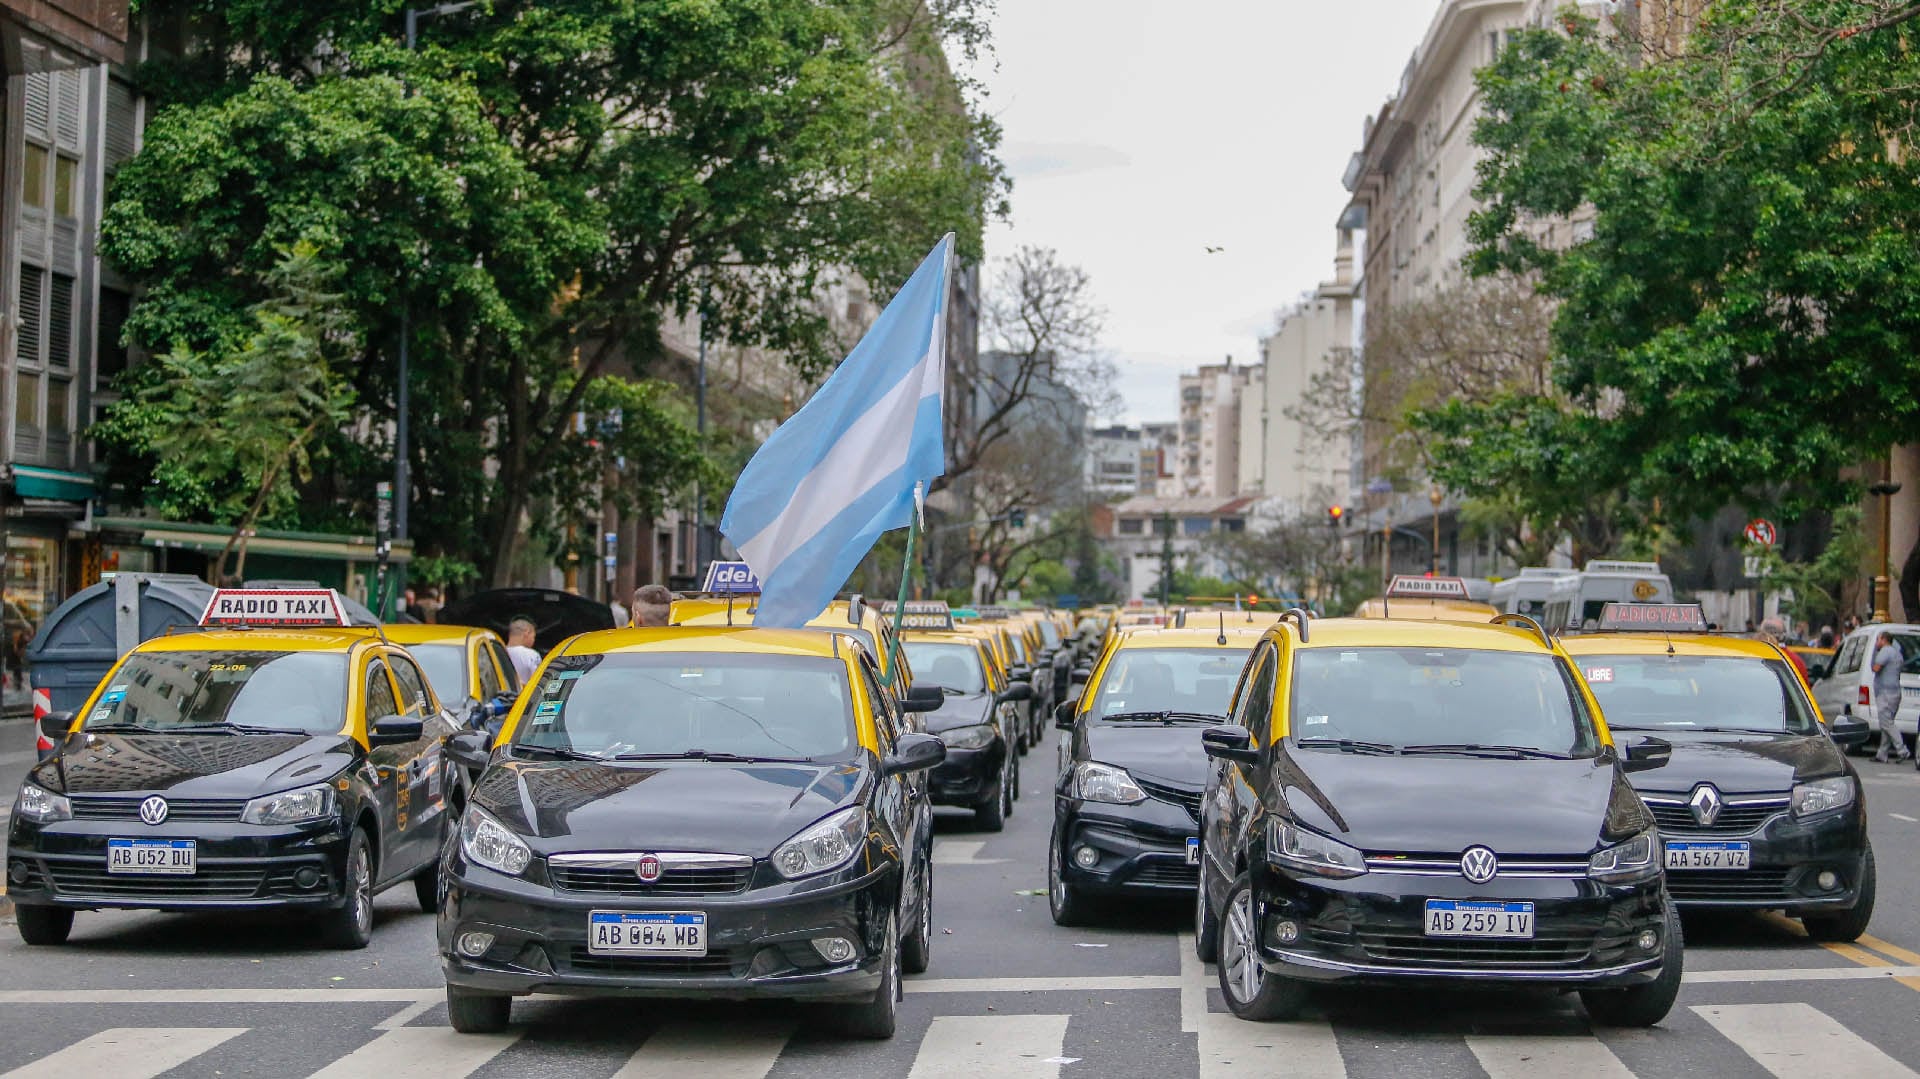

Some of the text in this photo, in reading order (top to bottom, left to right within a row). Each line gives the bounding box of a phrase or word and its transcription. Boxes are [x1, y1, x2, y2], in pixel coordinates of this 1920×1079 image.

[1398, 581, 1459, 592] RADIO TAXI
[220, 599, 326, 614] RADIO TAXI
[1588, 668, 1613, 681] LIBRE
[113, 849, 191, 866] AB 052 DU
[1670, 851, 1745, 867] AA 567 VZ
[641, 862, 657, 875] FIAT
[1431, 912, 1528, 933] AB 259 IV
[598, 925, 622, 945] AB
[674, 926, 698, 946] WB
